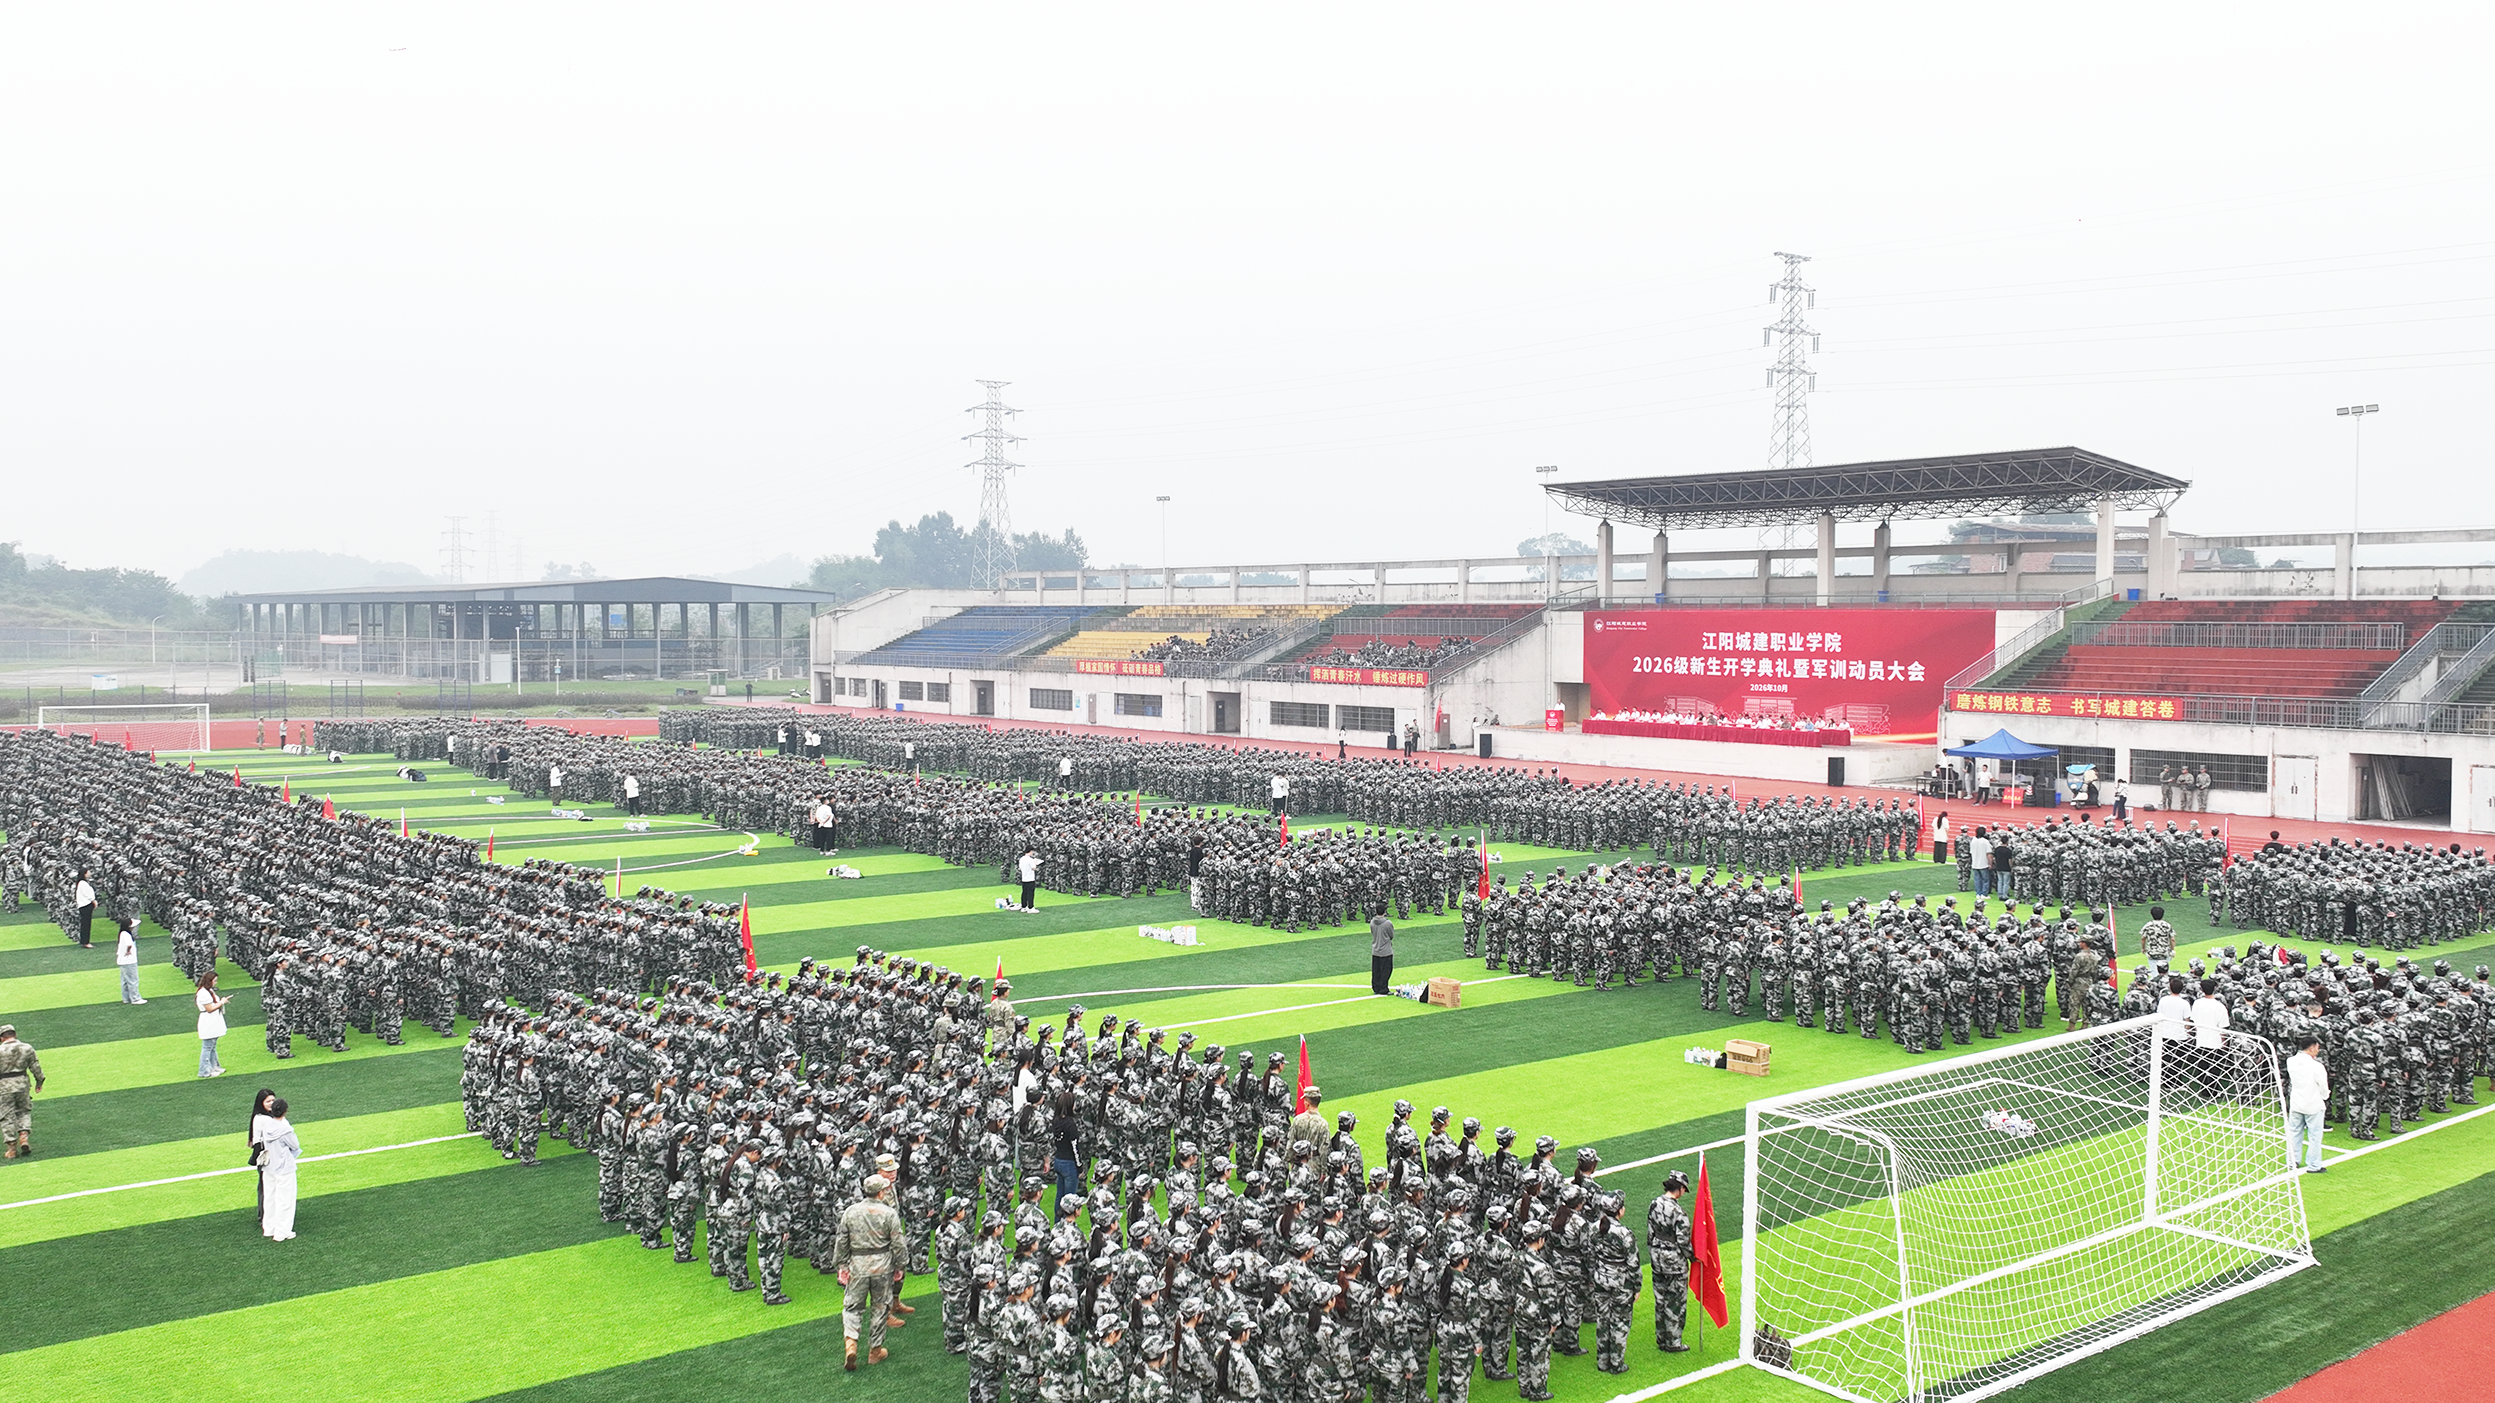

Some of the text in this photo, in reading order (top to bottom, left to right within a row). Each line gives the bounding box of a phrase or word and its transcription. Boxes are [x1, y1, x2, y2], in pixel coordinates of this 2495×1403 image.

[1702, 632, 1842, 652] 江阳城建职业学院
[1313, 668, 1425, 685] 挥洒青春汗水 锤炼过硬作风
[1632, 656, 1926, 682] 2026级新生开学典礼暨军训动员大会
[1750, 684, 1788, 692] 2026年10月
[1956, 693, 2175, 718] 磨炼钢铁意志 书写城建答卷
